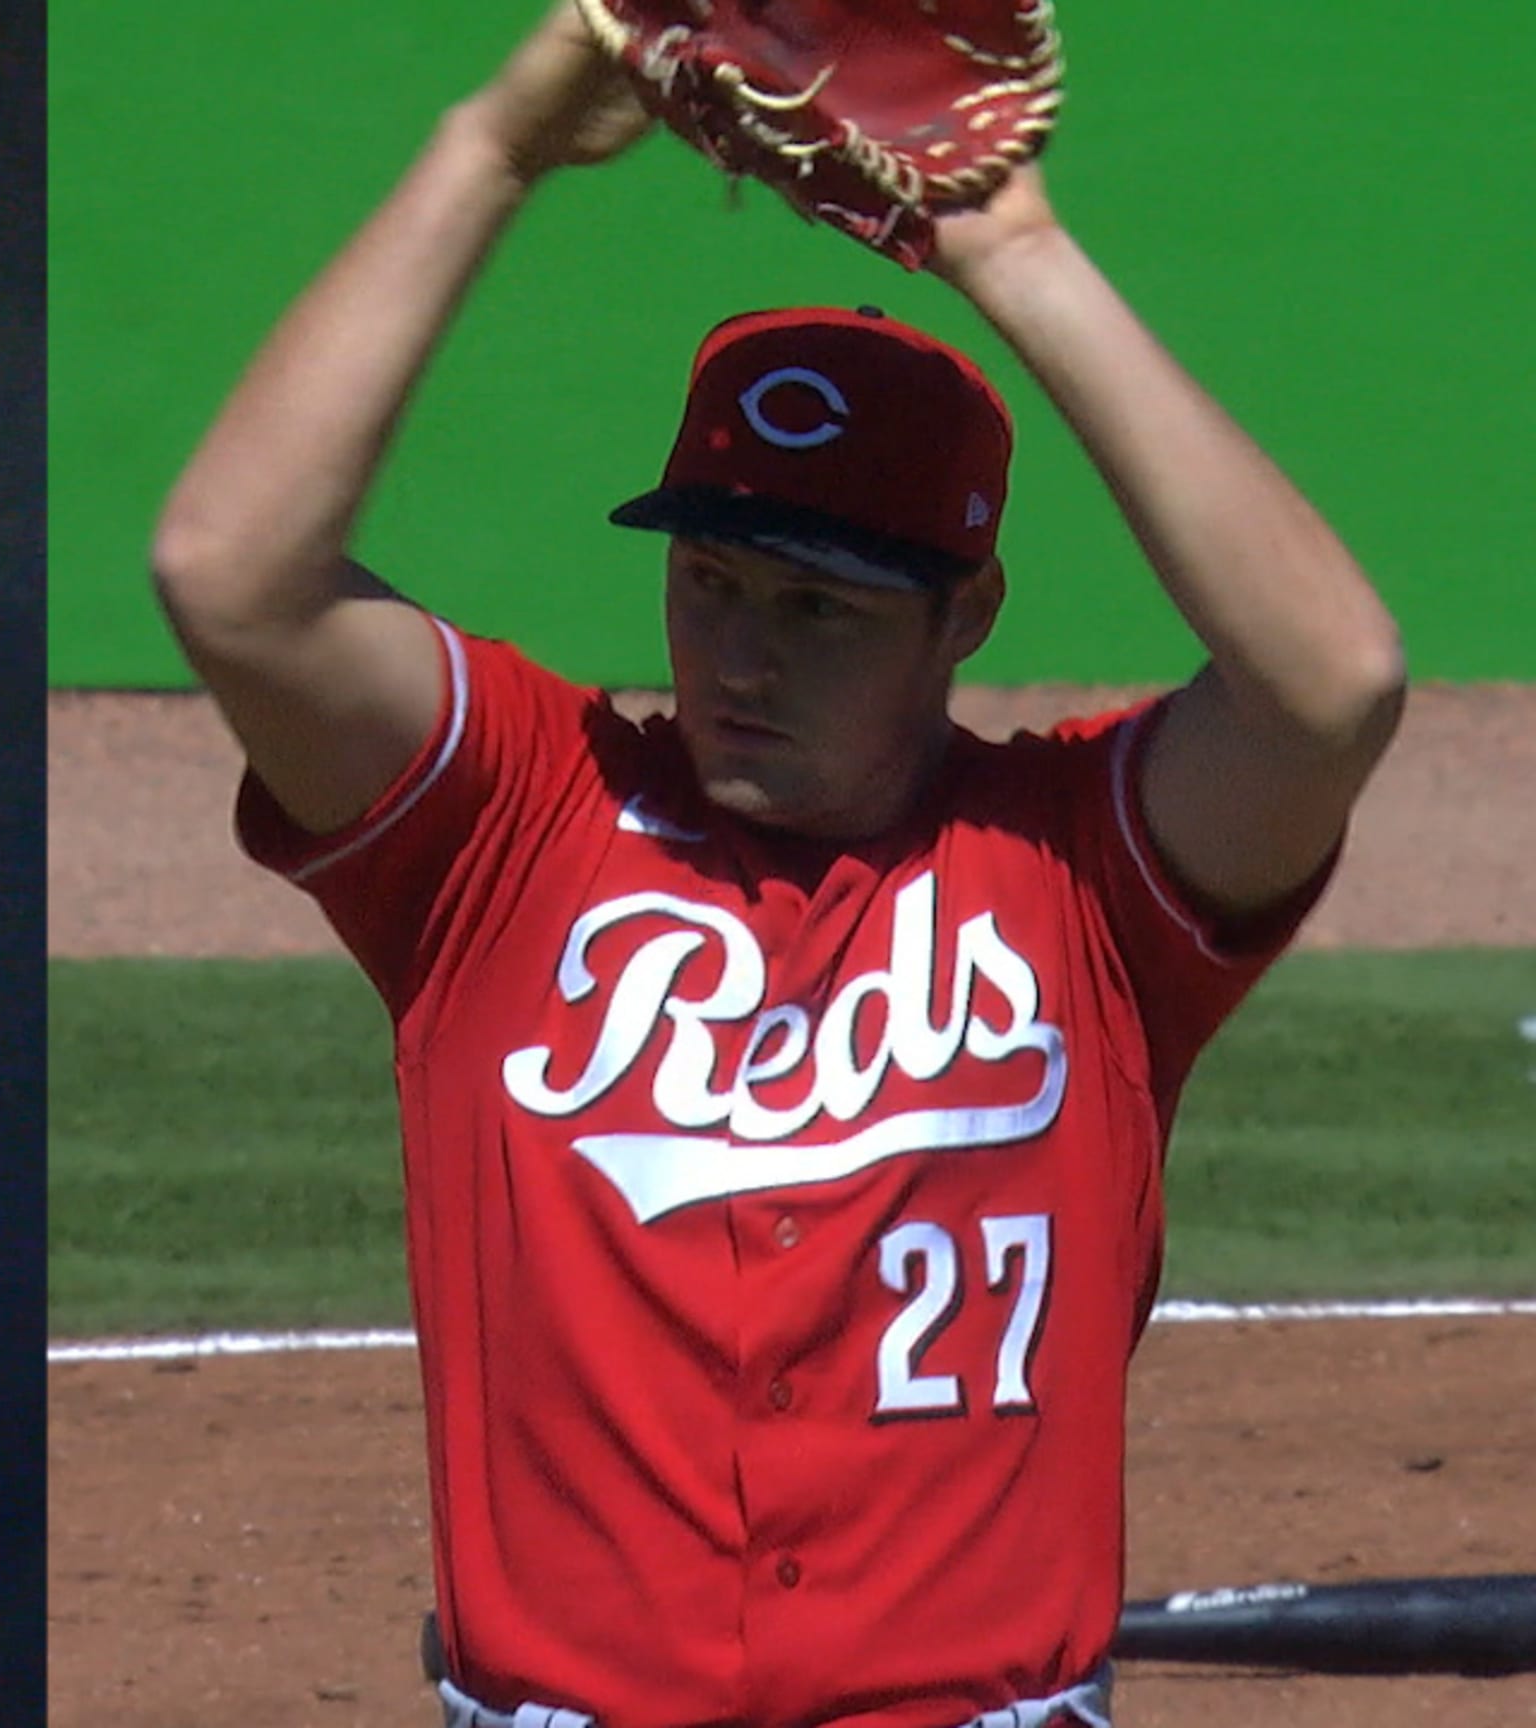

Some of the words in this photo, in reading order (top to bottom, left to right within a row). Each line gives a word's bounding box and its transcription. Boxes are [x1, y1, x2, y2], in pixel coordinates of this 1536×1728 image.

[737, 366, 851, 449] C
[502, 869, 1066, 1142] Reds
[871, 1213, 1056, 1424] 27
